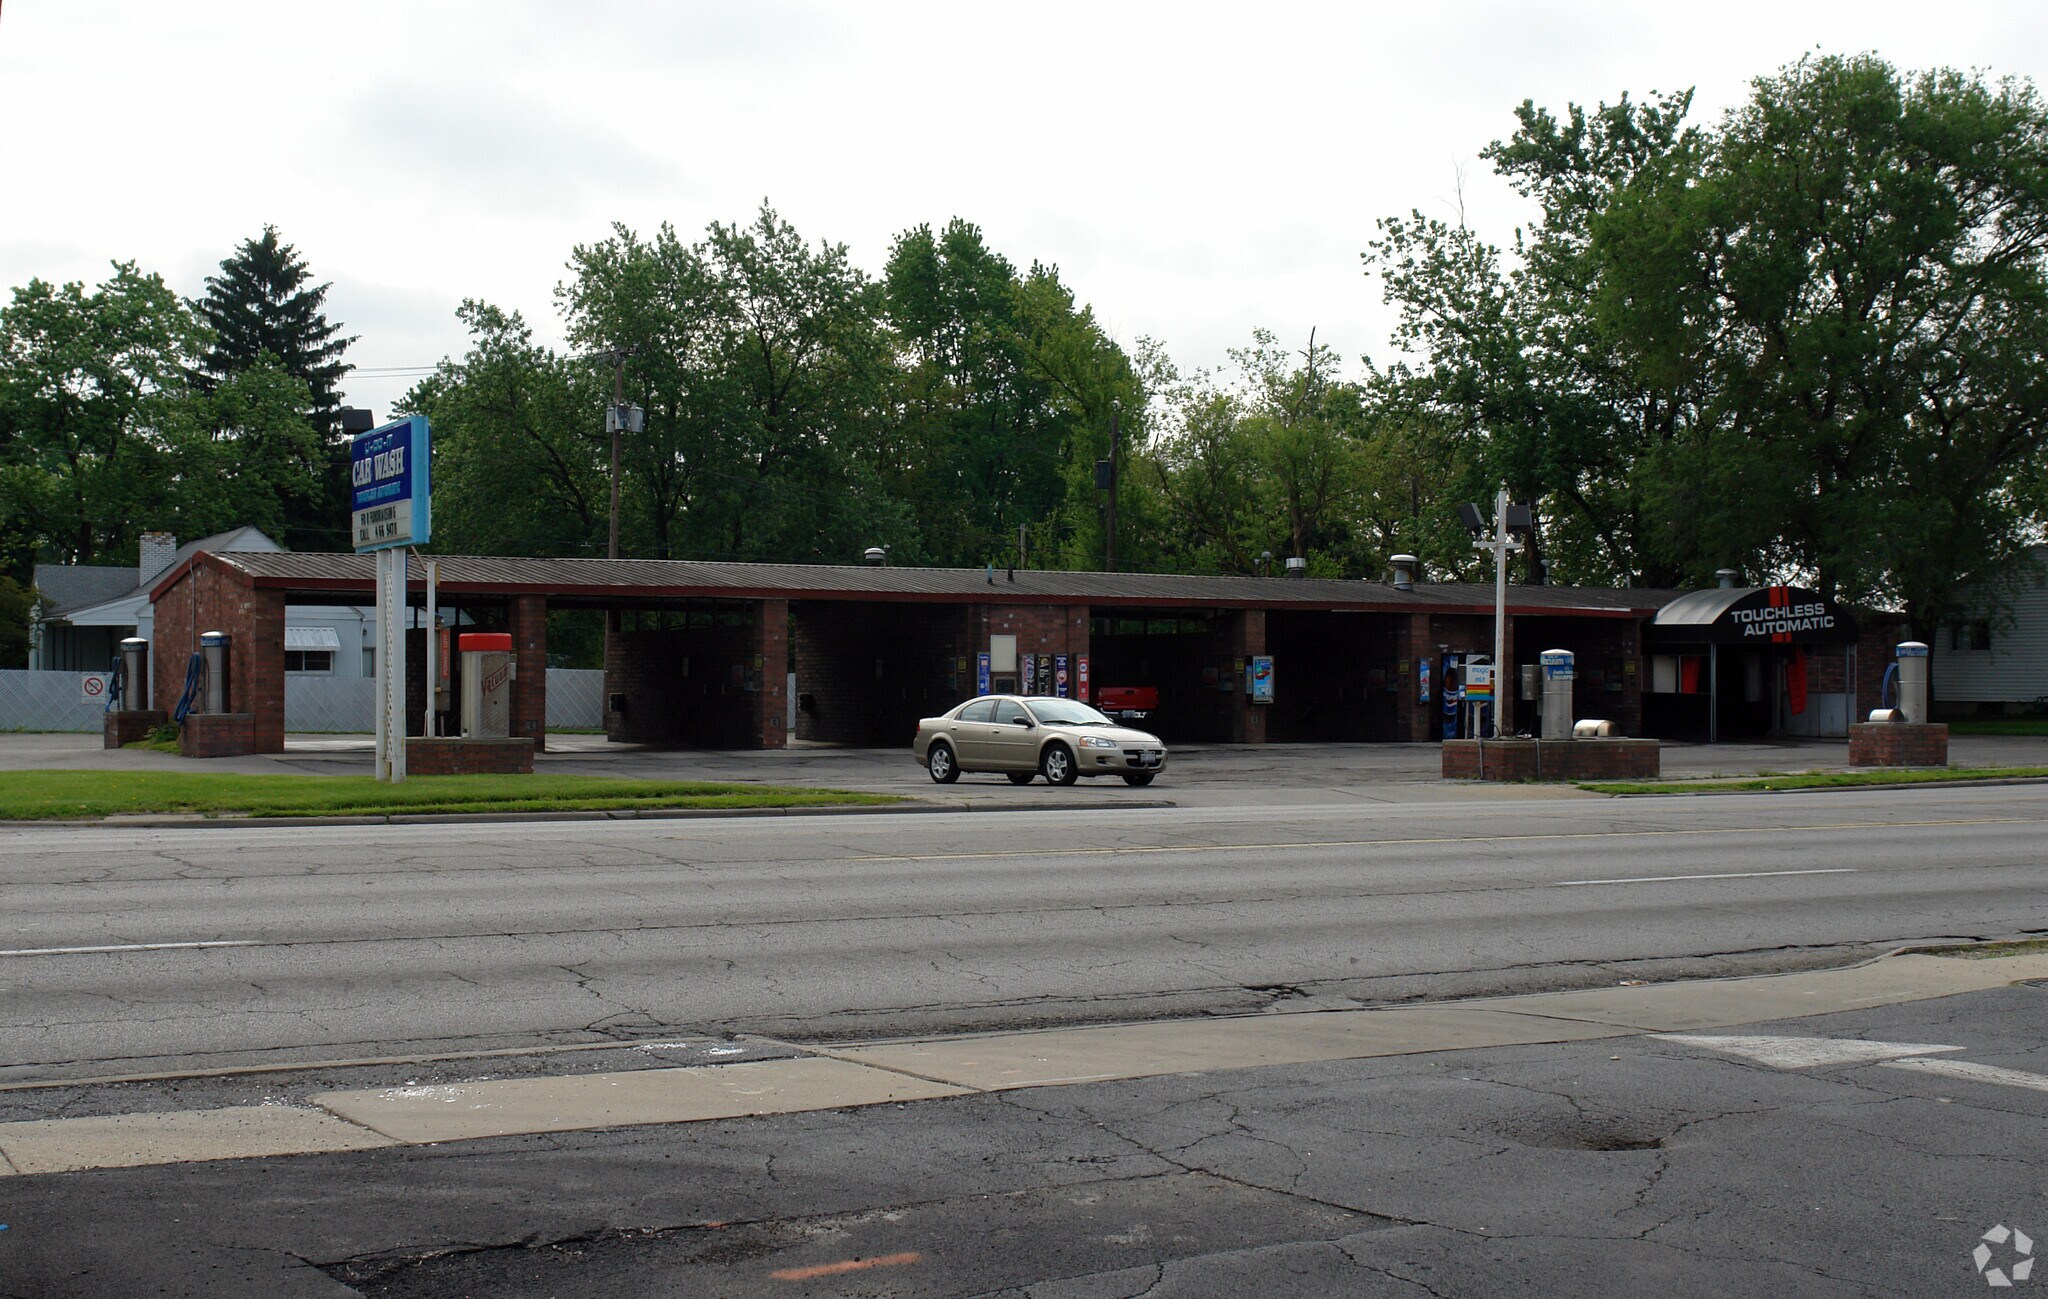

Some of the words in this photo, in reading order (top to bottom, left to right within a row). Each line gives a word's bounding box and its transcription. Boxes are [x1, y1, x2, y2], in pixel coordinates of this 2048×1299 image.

[352, 457, 372, 487] CAR
[374, 446, 405, 481] WASH
[1731, 602, 1825, 624] TOUCHLESS
[1743, 615, 1835, 637] AUTOMATIC
